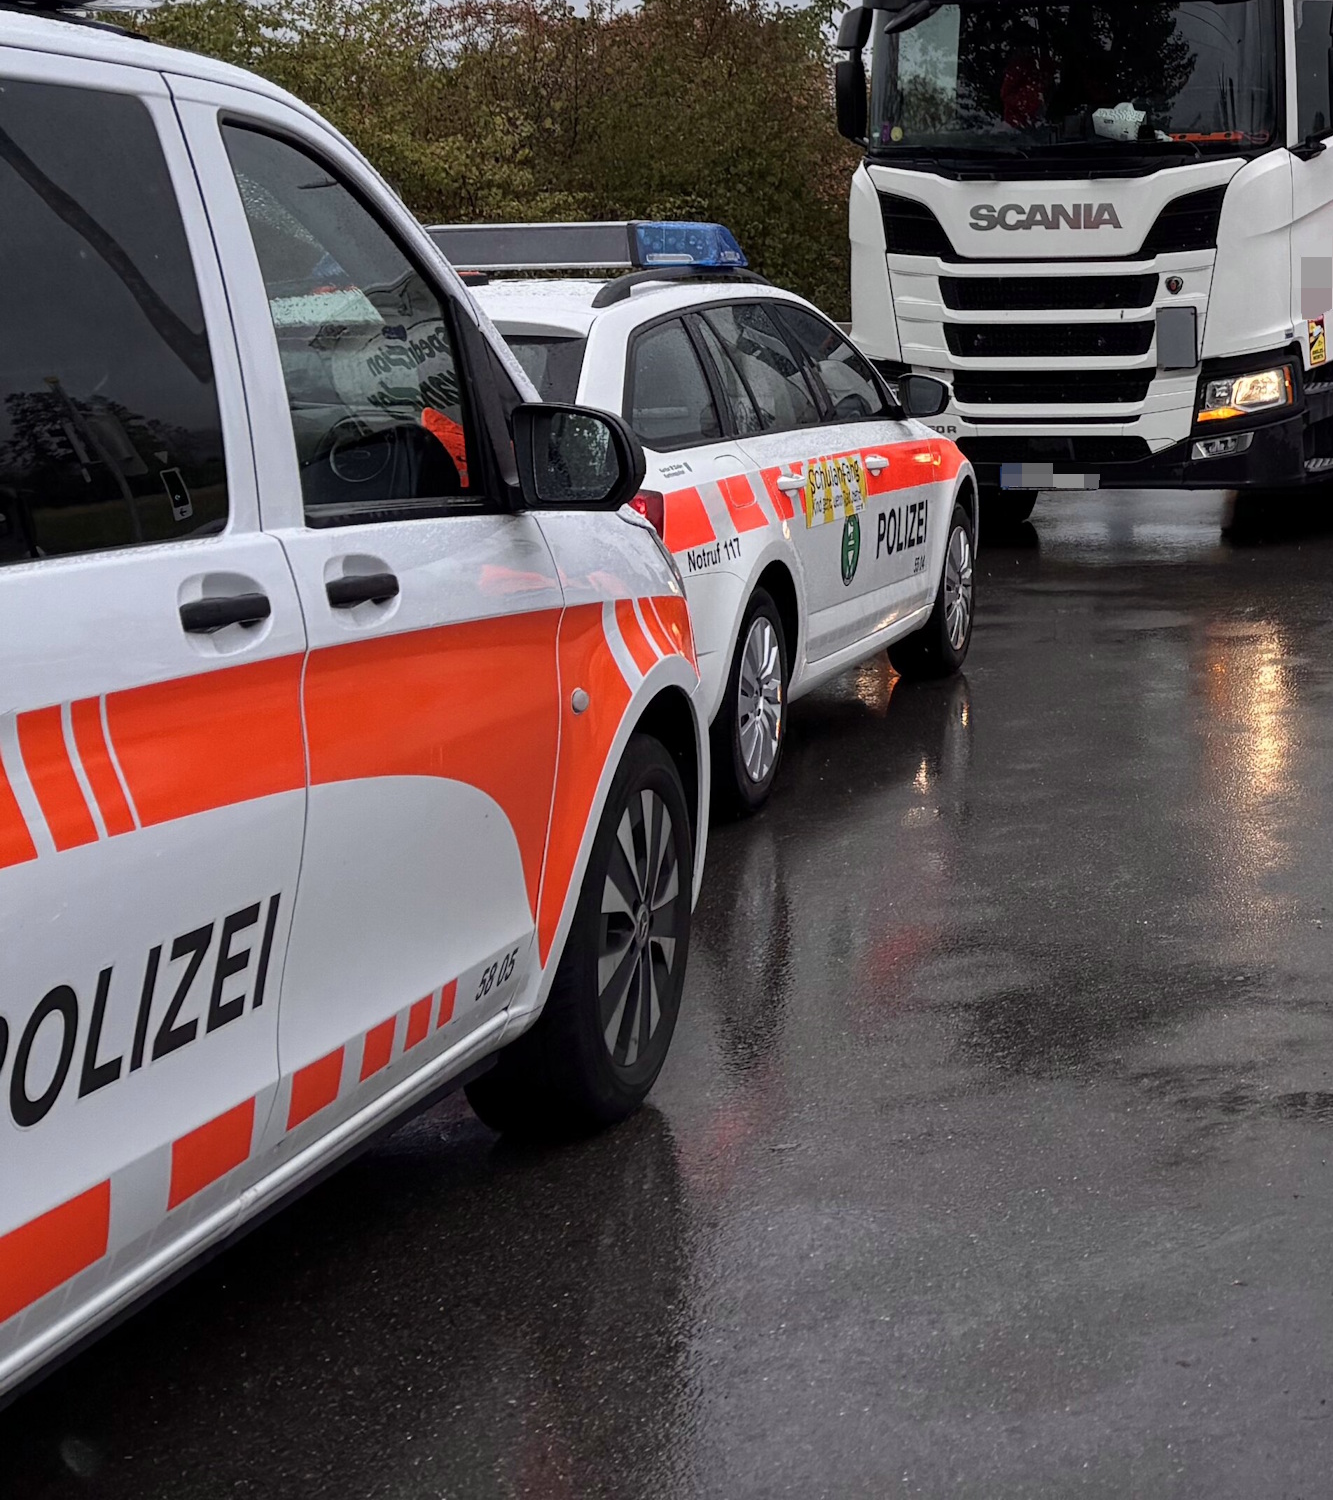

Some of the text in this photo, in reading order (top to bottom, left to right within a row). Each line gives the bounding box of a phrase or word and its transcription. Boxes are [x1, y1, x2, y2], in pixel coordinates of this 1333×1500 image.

[969, 203, 1123, 231] SCANIA
[808, 460, 860, 495] Schulanfang
[876, 499, 928, 560] POLIZEI
[687, 537, 741, 573] Notruf 117
[475, 947, 519, 1001] 58 05
